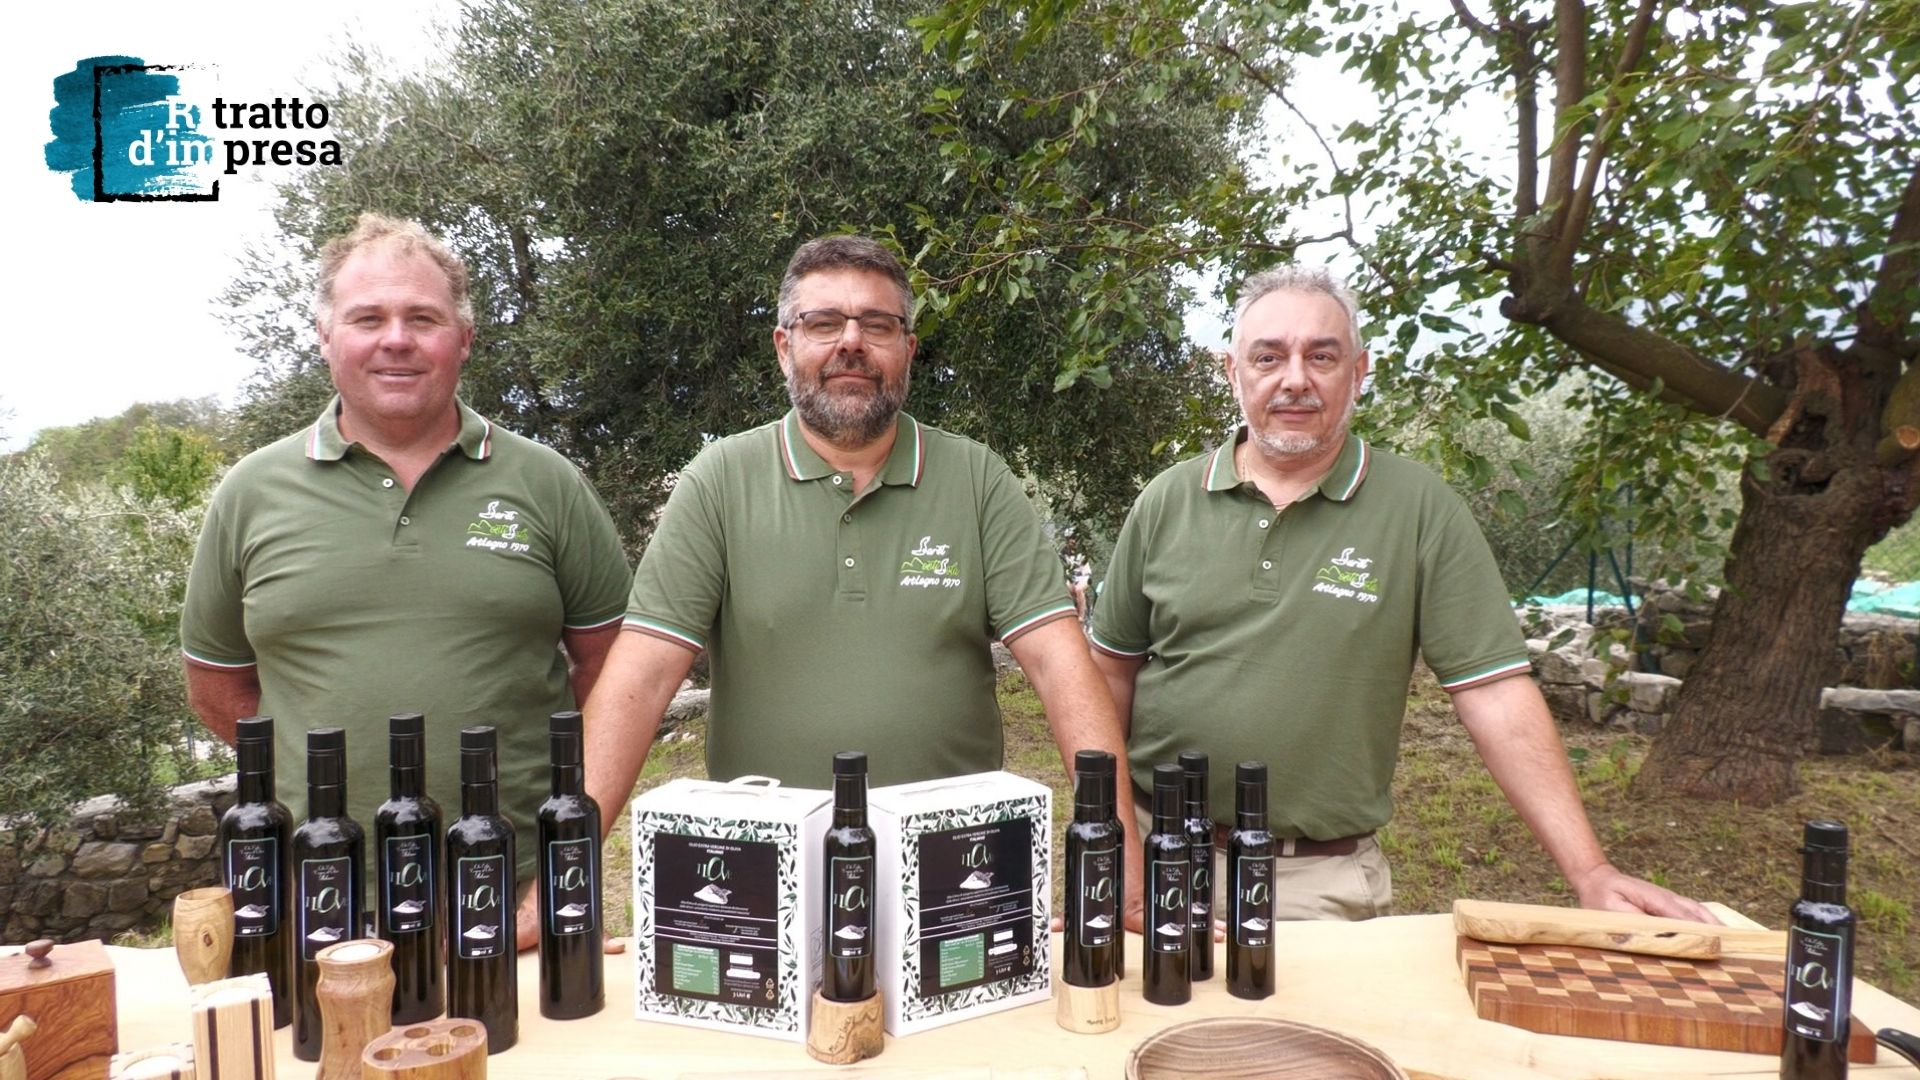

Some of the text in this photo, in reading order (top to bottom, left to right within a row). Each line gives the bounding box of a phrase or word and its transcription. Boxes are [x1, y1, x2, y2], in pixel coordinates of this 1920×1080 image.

[510, 541, 530, 552] 1970
[942, 577, 961, 588] 1970
[1356, 591, 1378, 603] 1970
